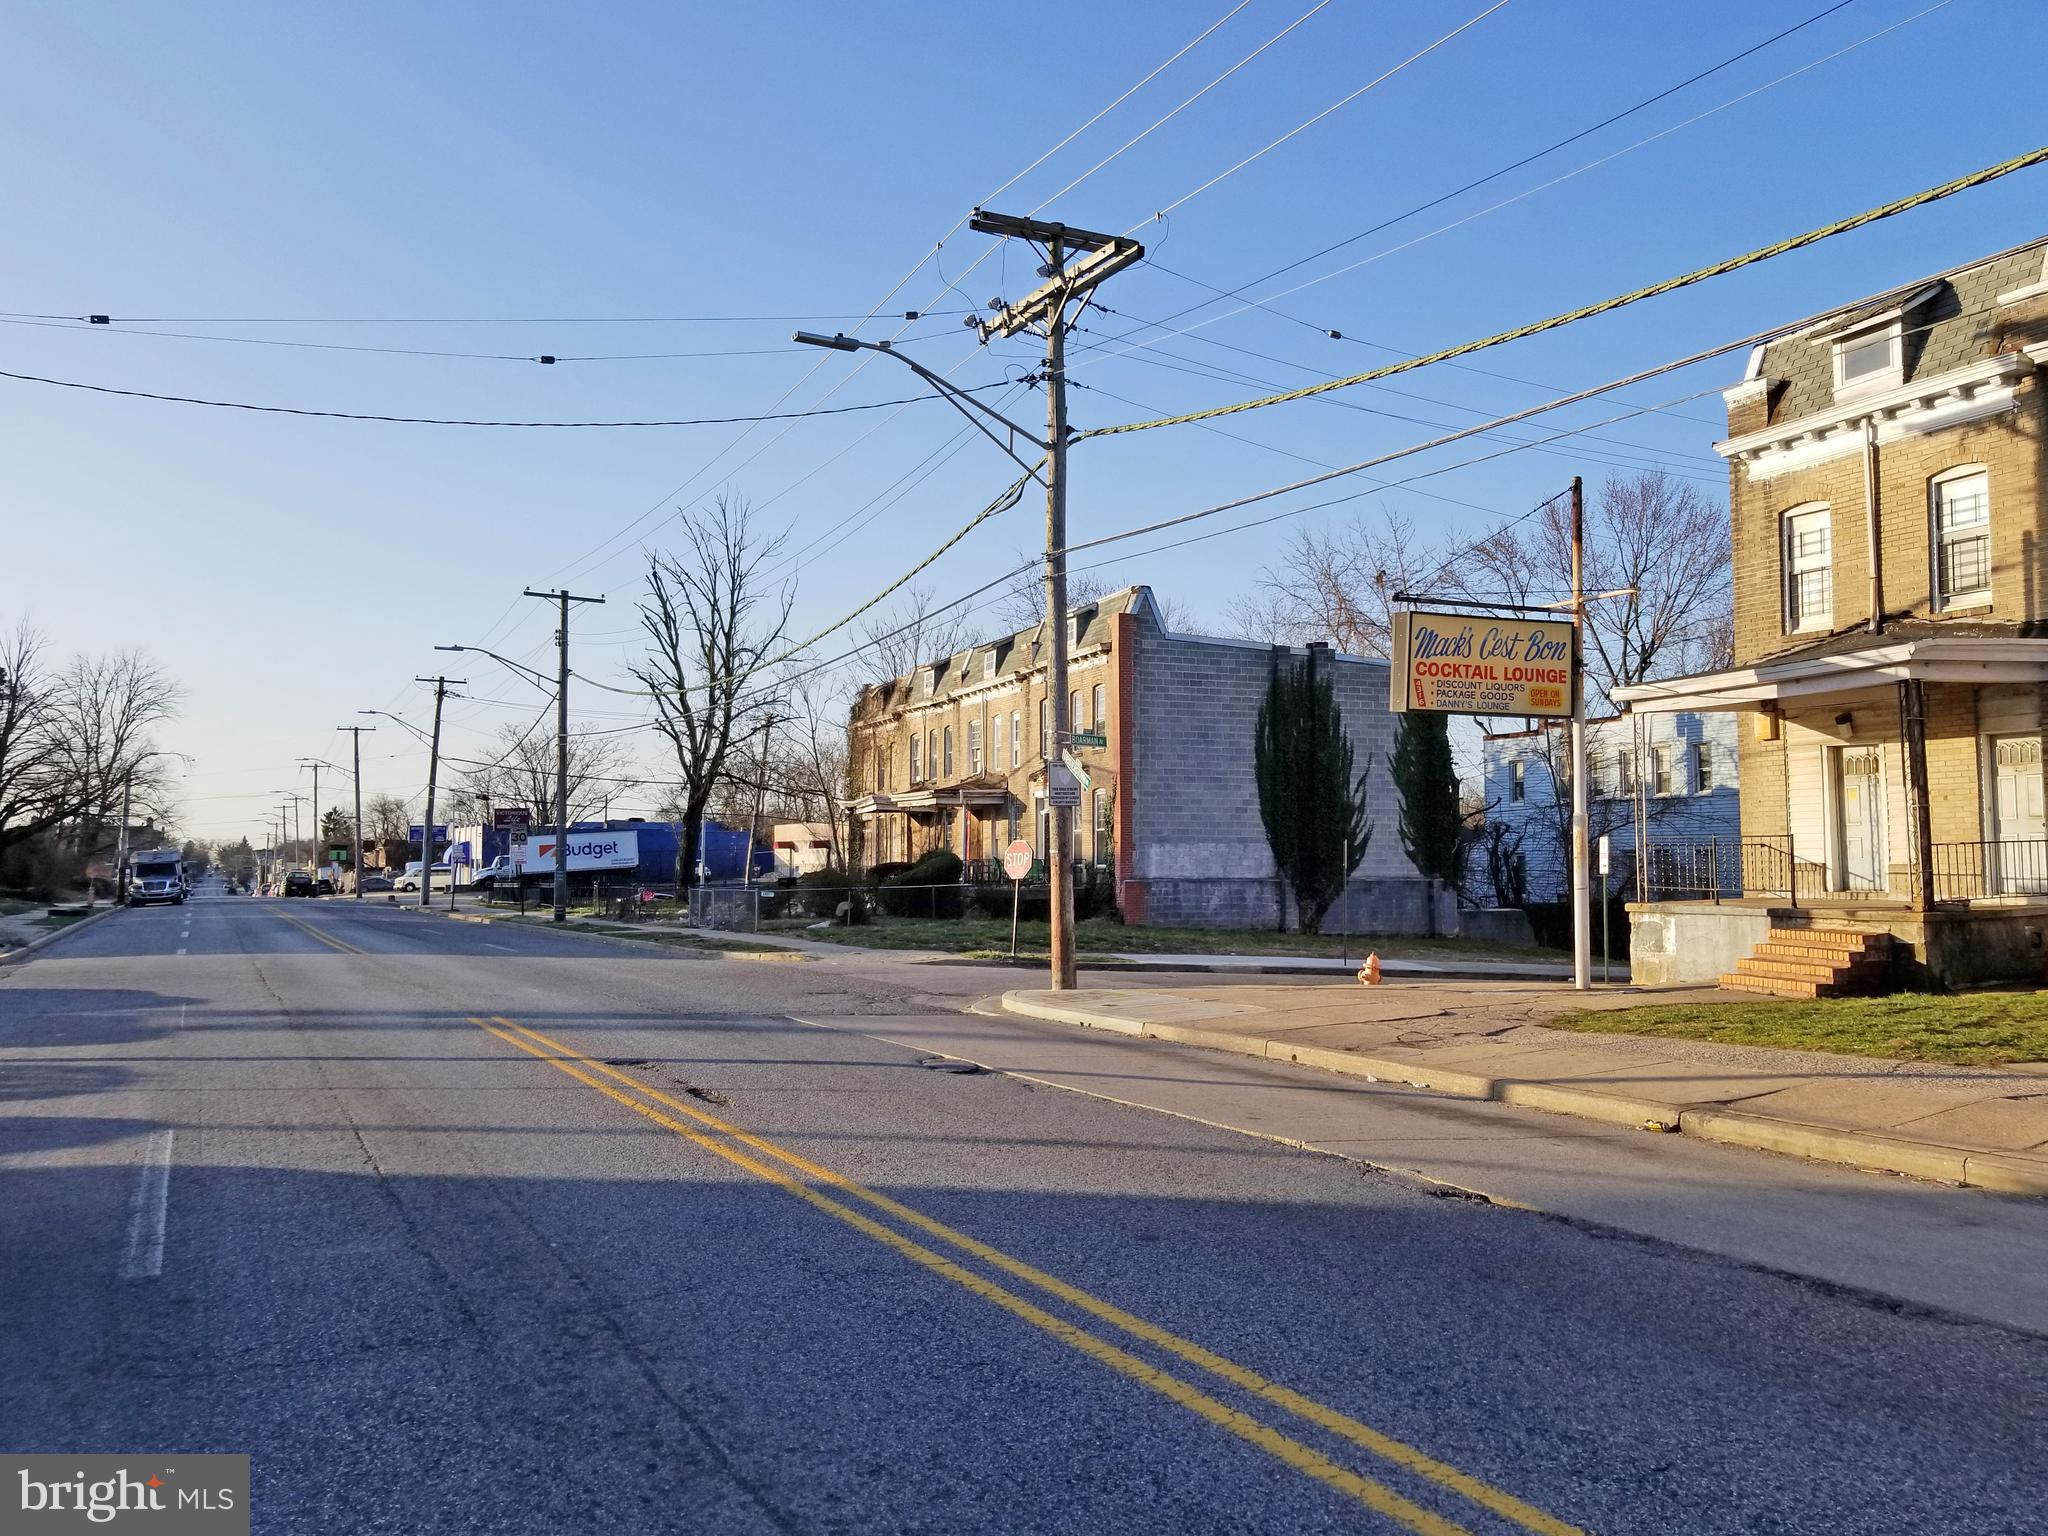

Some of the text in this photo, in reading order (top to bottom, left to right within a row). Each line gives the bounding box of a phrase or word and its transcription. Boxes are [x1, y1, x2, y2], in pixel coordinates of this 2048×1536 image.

[1414, 626, 1567, 662] Mack's C'est Bon
[1415, 661, 1567, 684] COCKTAIL LOUNGE
[1436, 680, 1526, 692] DISCOUNT LIQUORS
[1436, 690, 1515, 701] PACKAGE GOODS
[1530, 689, 1560, 699] OPEN ON
[1436, 700, 1510, 711] DANNY'S LOUNGE
[1530, 698, 1562, 708] SUNDAYS
[1071, 735, 1099, 746] BOARMAN
[511, 832, 527, 842] 30
[1006, 852, 1030, 867] STOP
